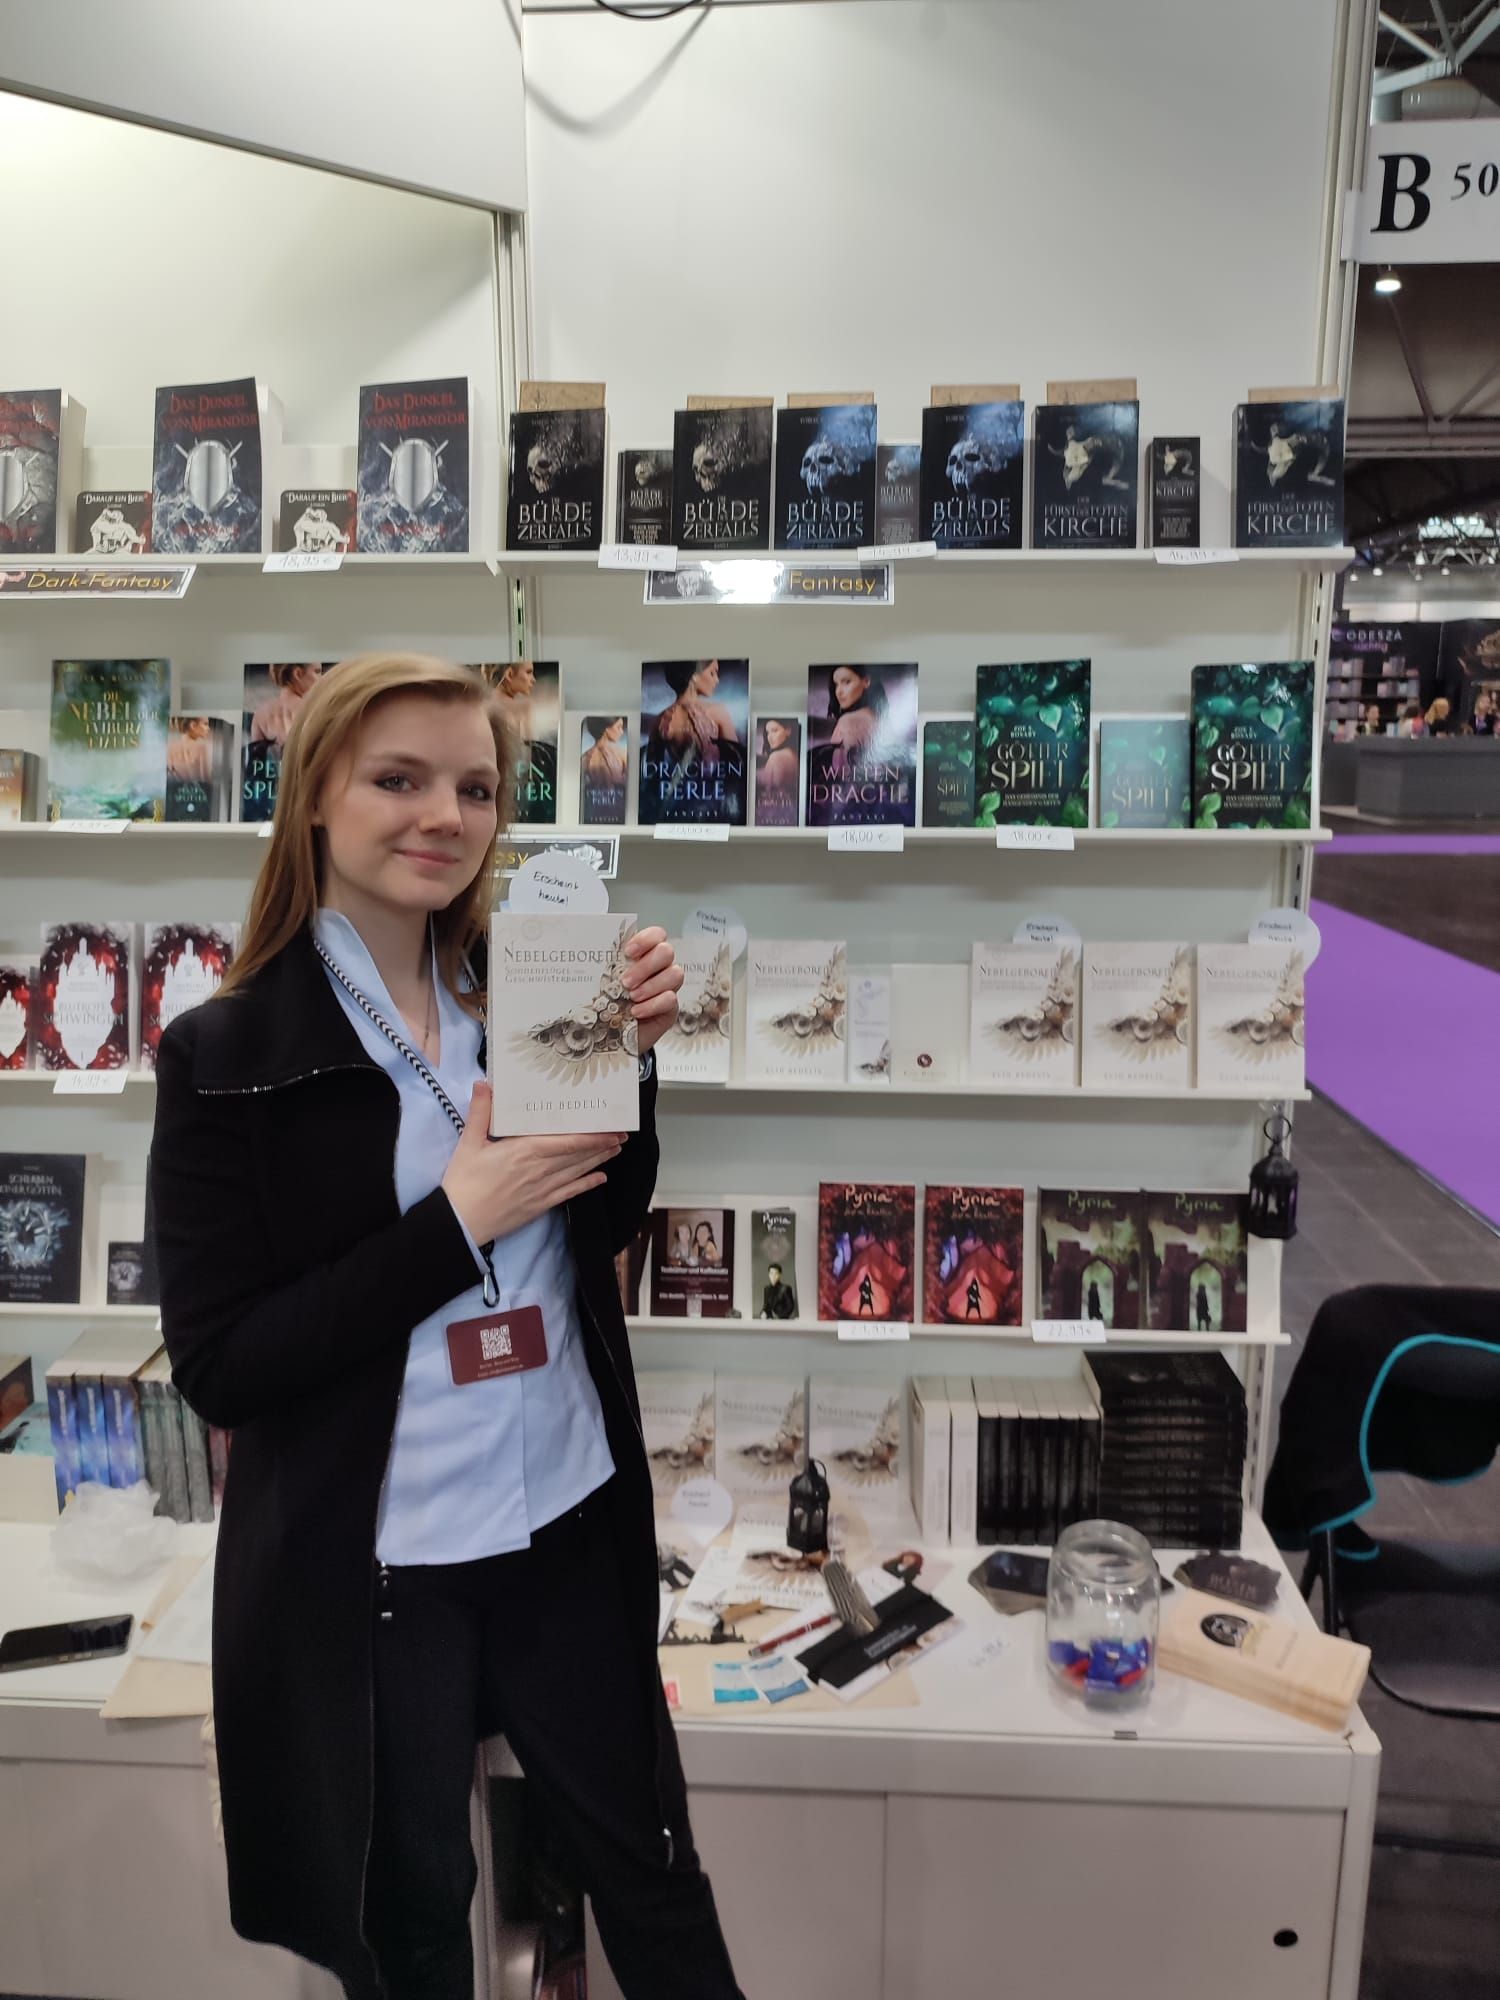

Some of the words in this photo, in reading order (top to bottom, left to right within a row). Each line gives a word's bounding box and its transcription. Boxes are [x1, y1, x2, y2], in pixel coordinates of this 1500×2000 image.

[1370, 154, 1431, 233] B
[1451, 162, 1500, 200] 50
[1156, 487, 1195, 497] KIRCHE
[519, 500, 592, 524] BÜRDE
[684, 499, 759, 523] BÜRDE
[788, 499, 864, 522] BÜRDE
[933, 497, 1010, 521] BÜRDE
[517, 523, 592, 540] ZERFALLS
[683, 522, 759, 539] ZERFALLS
[786, 522, 864, 540] ZERFALLS
[931, 519, 1010, 538] ZERFALLS
[1044, 517, 1128, 537] KIRCHE
[1248, 513, 1335, 535] KIRCHE
[789, 571, 876, 595] Fantasy
[642, 761, 743, 779] DRACHEN
[822, 767, 899, 782] WELTEN
[991, 759, 1065, 789] SPIEL
[1211, 761, 1288, 791] SPIEL
[661, 781, 725, 800] PERLE
[812, 783, 908, 804] DRACHE
[534, 871, 579, 890] Erscheint
[525, 1100, 553, 1113] ELIN
[559, 1099, 608, 1111] BEDELIS
[845, 1184, 892, 1208] Pyria
[952, 1186, 1000, 1212] Pyria
[1068, 1191, 1114, 1213] Pyria
[1175, 1193, 1222, 1216] Pyria
[762, 1212, 791, 1225] Pyria
